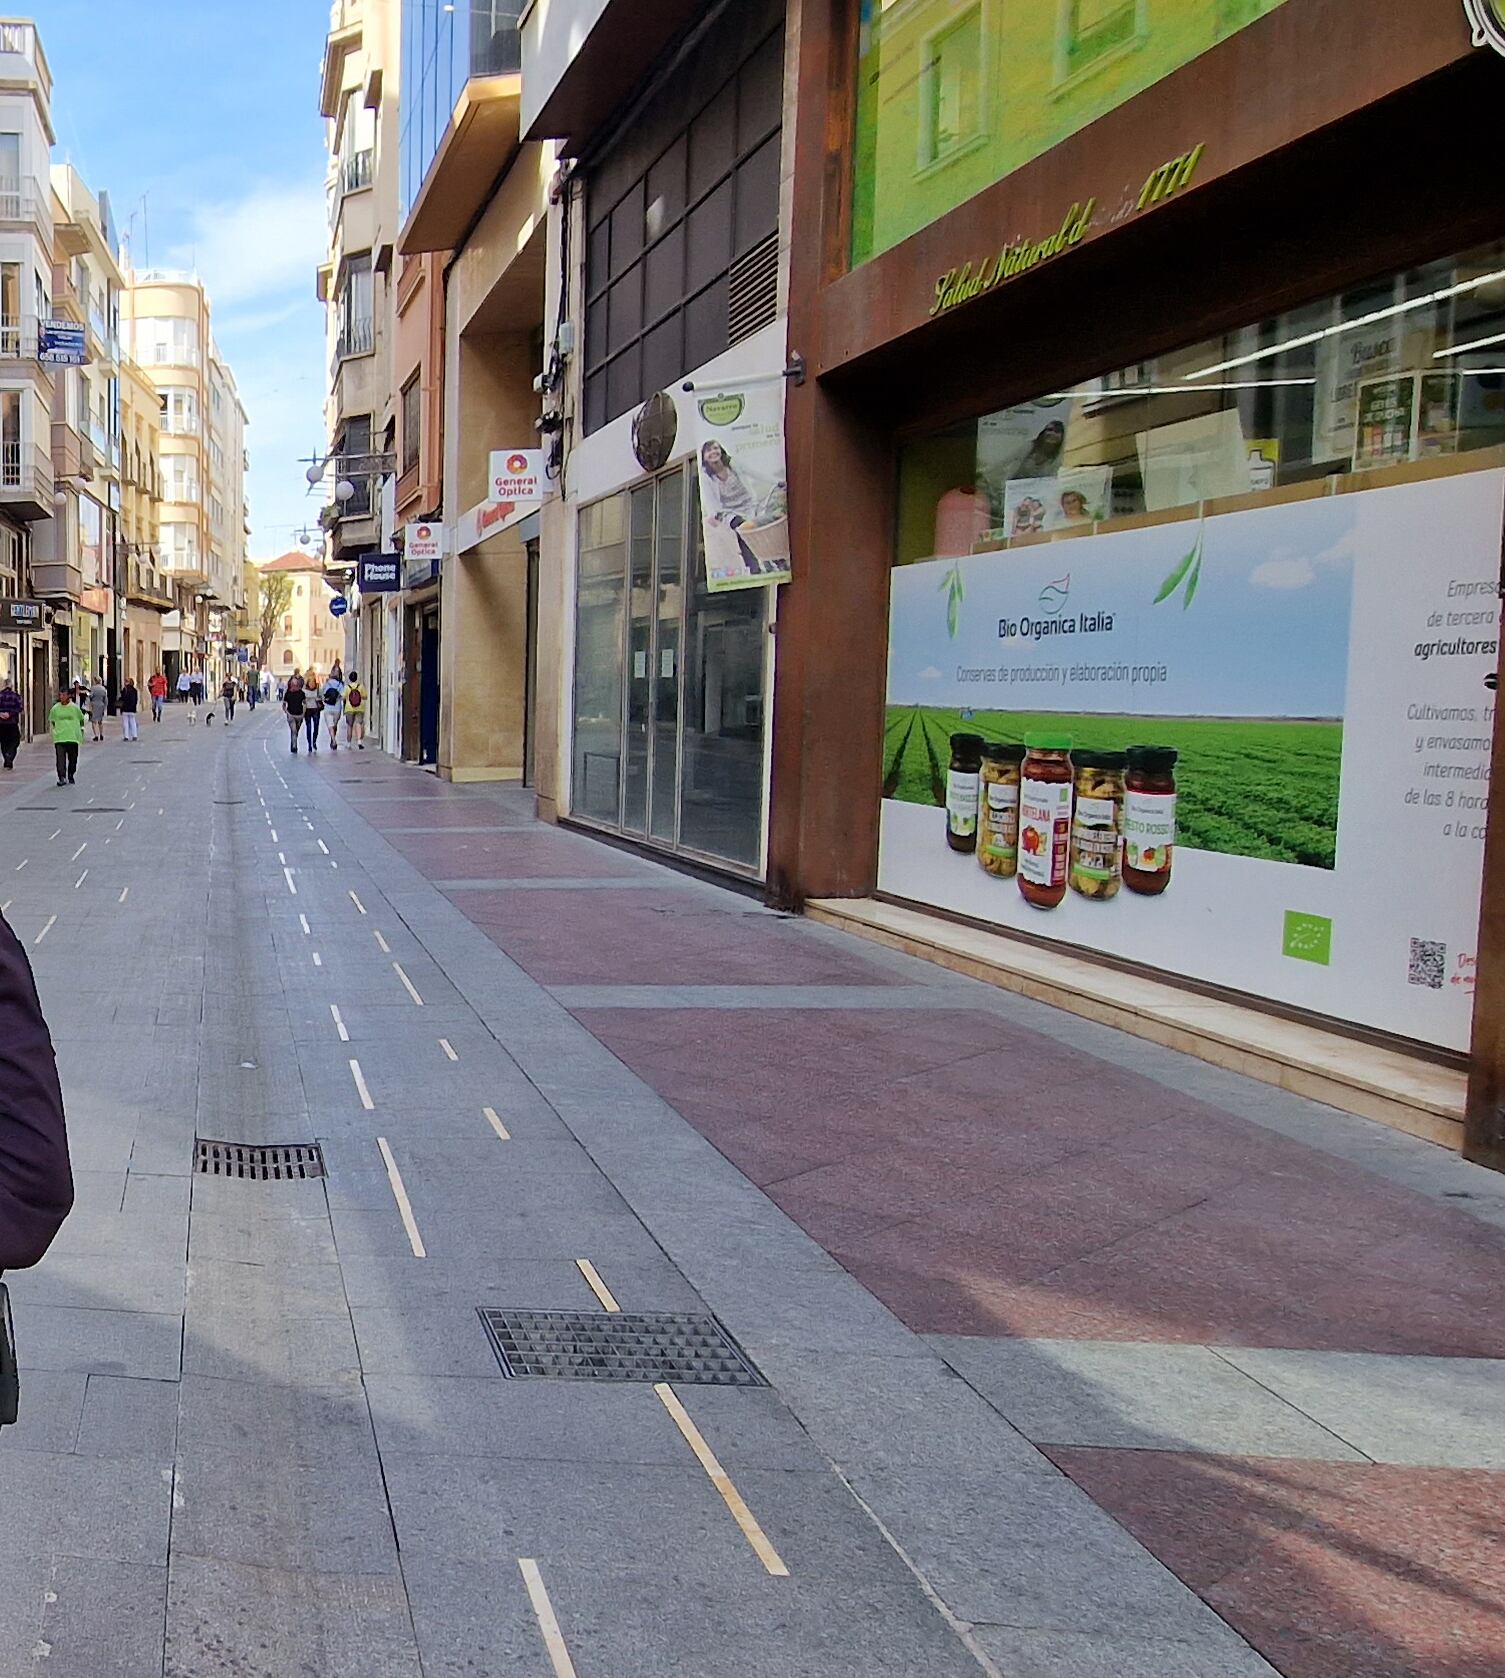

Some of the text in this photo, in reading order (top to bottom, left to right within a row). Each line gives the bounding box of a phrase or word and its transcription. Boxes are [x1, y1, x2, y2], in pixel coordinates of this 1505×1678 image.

[495, 476, 537, 487] General
[498, 487, 534, 498] Optica
[409, 541, 438, 549] General
[364, 563, 396, 572] Phone
[364, 571, 396, 581] House
[998, 610, 1114, 641] Bio Organica Italia
[1427, 610, 1494, 628] de tercera
[1414, 636, 1498, 661] agricultores
[956, 665, 996, 683] Conservas
[1060, 667, 1068, 686] y
[1070, 661, 1129, 683] elaboración
[1131, 661, 1168, 687] propia
[1415, 736, 1423, 753] y
[1404, 787, 1420, 805] de
[1423, 788, 1441, 806] las
[1445, 790, 1455, 807] 8
[1443, 822, 1452, 836] a
[1455, 821, 1468, 838] la
